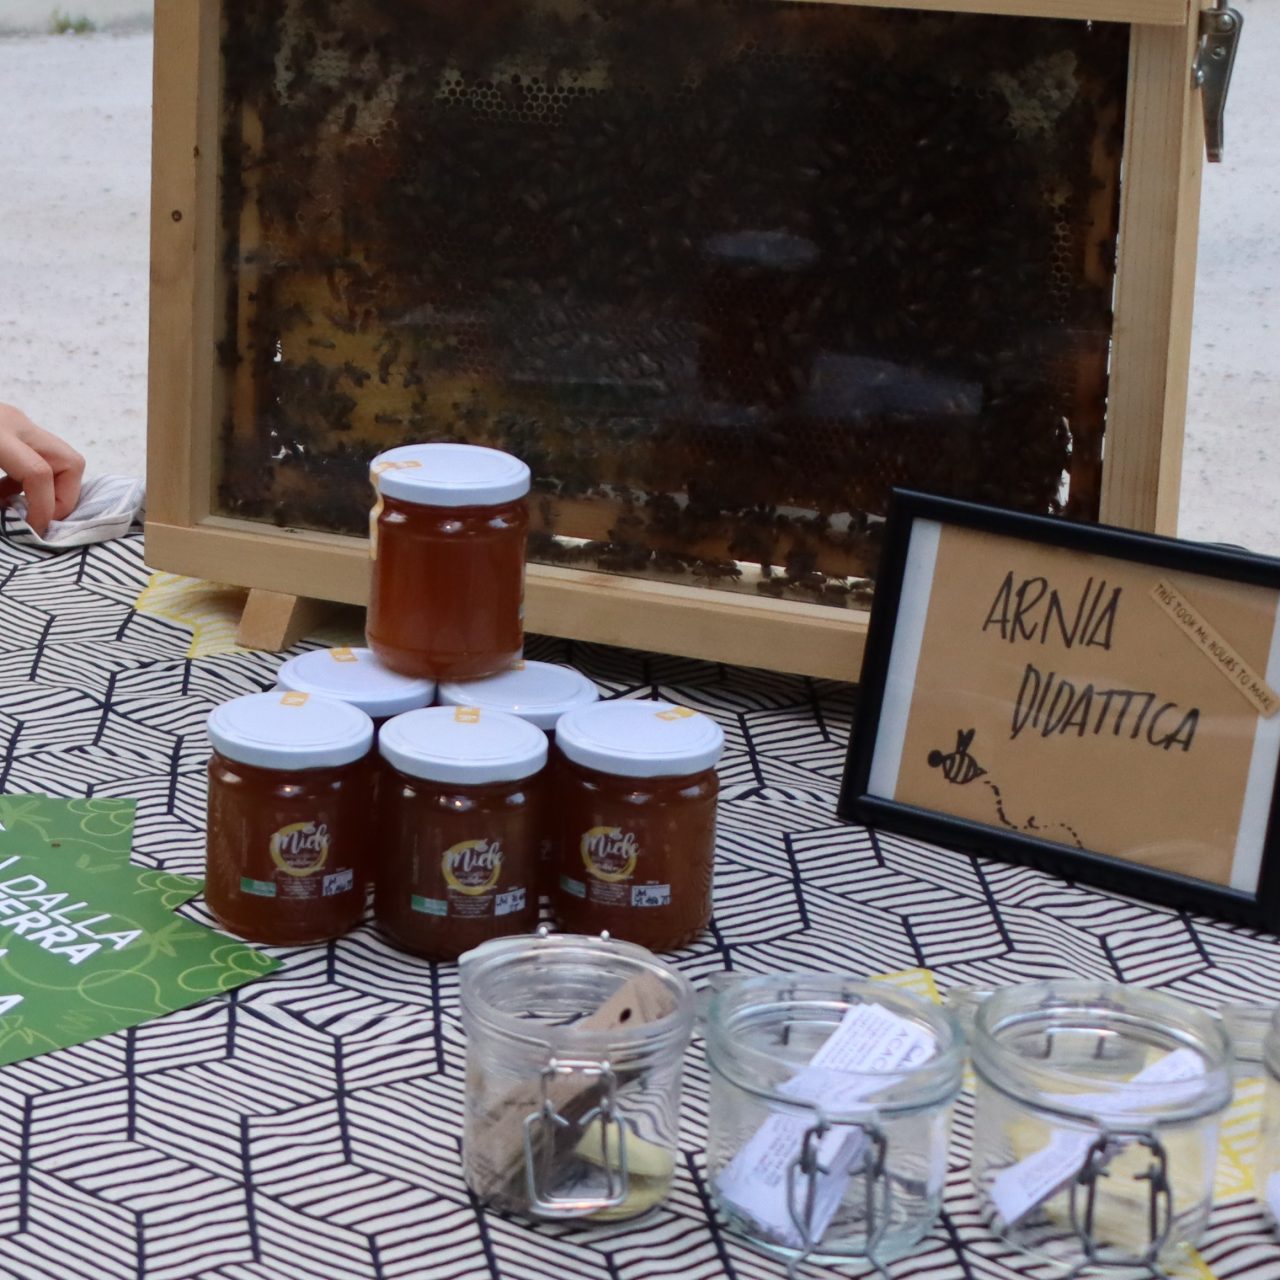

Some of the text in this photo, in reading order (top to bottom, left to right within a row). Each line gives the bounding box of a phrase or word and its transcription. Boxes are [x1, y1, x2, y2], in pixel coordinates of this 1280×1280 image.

[982, 570, 1123, 651] ARNIA
[1153, 583, 1177, 606] THIS
[1172, 602, 1195, 627] TOOK
[1195, 626, 1209, 644] ME
[1208, 640, 1239, 672] HOURS
[1236, 669, 1250, 686] TO
[1009, 663, 1202, 752] DIDATTICA
